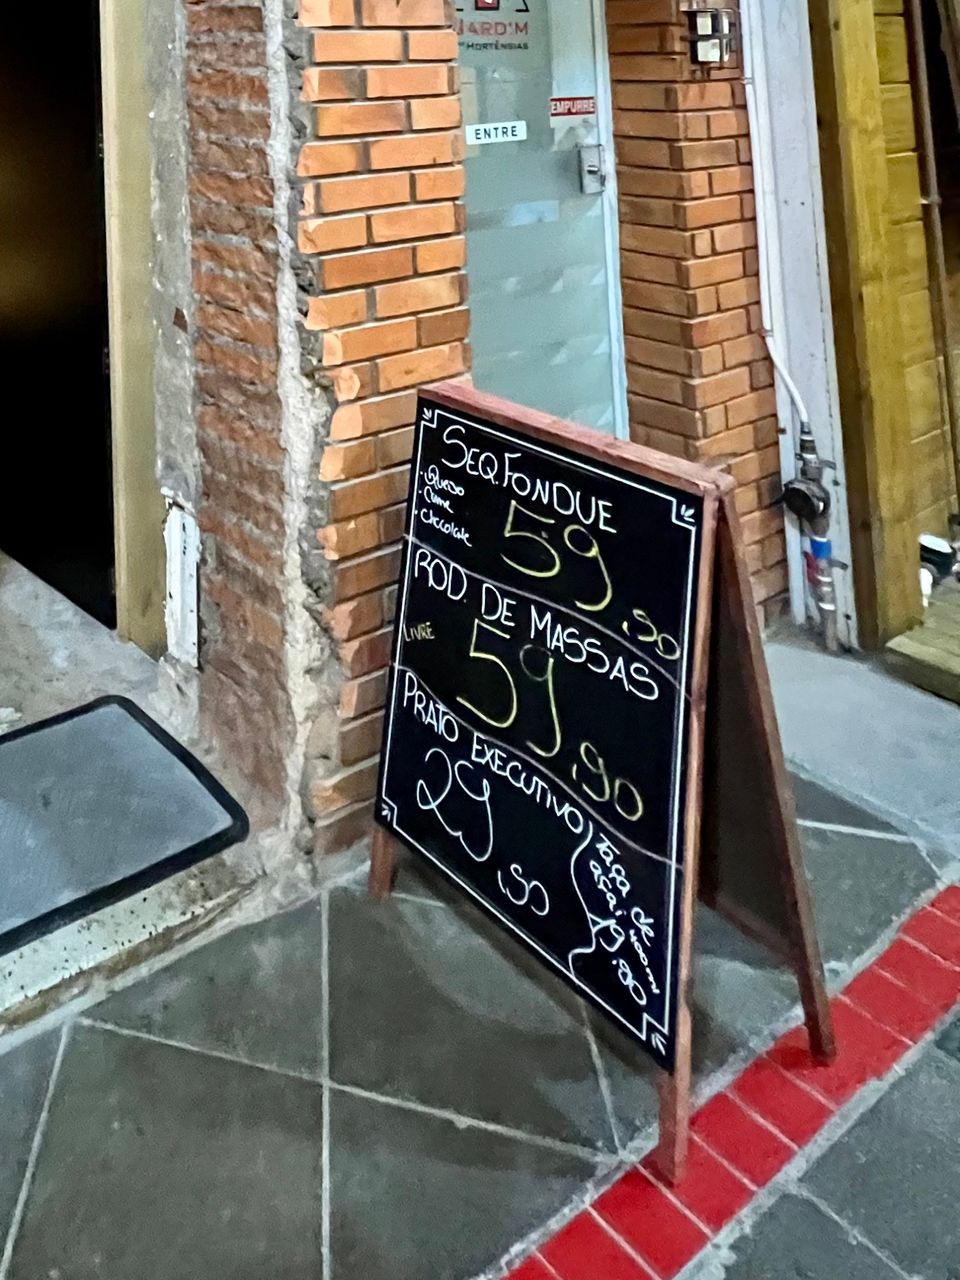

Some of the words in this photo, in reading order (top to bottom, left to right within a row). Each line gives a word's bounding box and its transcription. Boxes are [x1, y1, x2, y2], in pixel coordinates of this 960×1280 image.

[550, 99, 596, 114] EMPURRE
[474, 125, 519, 141] ENTRE
[481, 582, 517, 627] DE
[530, 604, 659, 701] MASSAS
[403, 671, 459, 742] PRATO
[471, 731, 584, 835] EXECUTIVO
[630, 906, 656, 948] de
